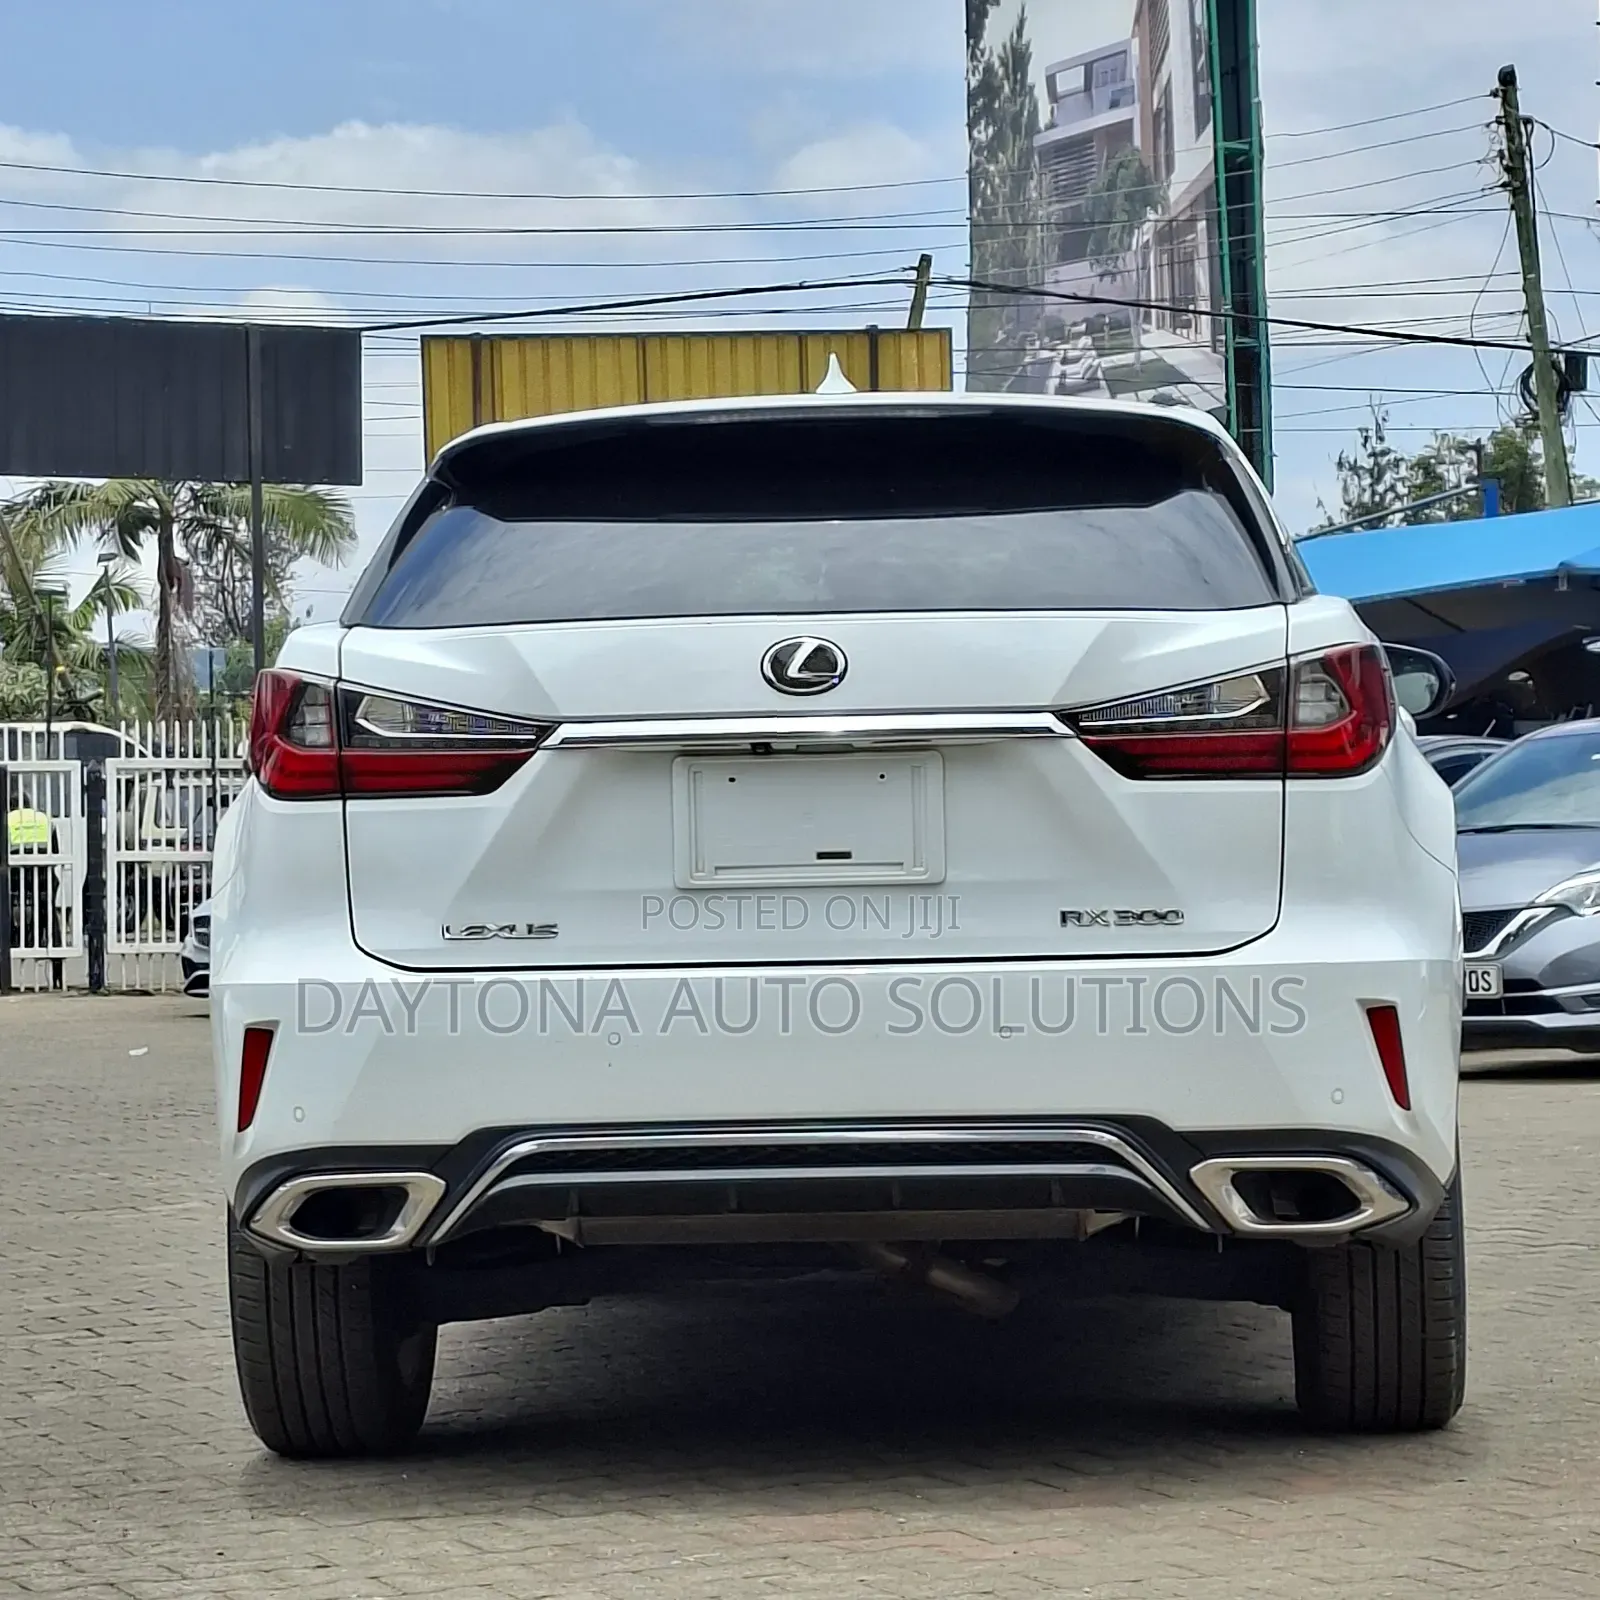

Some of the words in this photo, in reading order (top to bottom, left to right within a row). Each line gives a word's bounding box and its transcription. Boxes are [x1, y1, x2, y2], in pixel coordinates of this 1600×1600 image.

[1059, 909, 1110, 928] RX
[1112, 909, 1185, 926] 300
[441, 923, 559, 940] LEXUS
